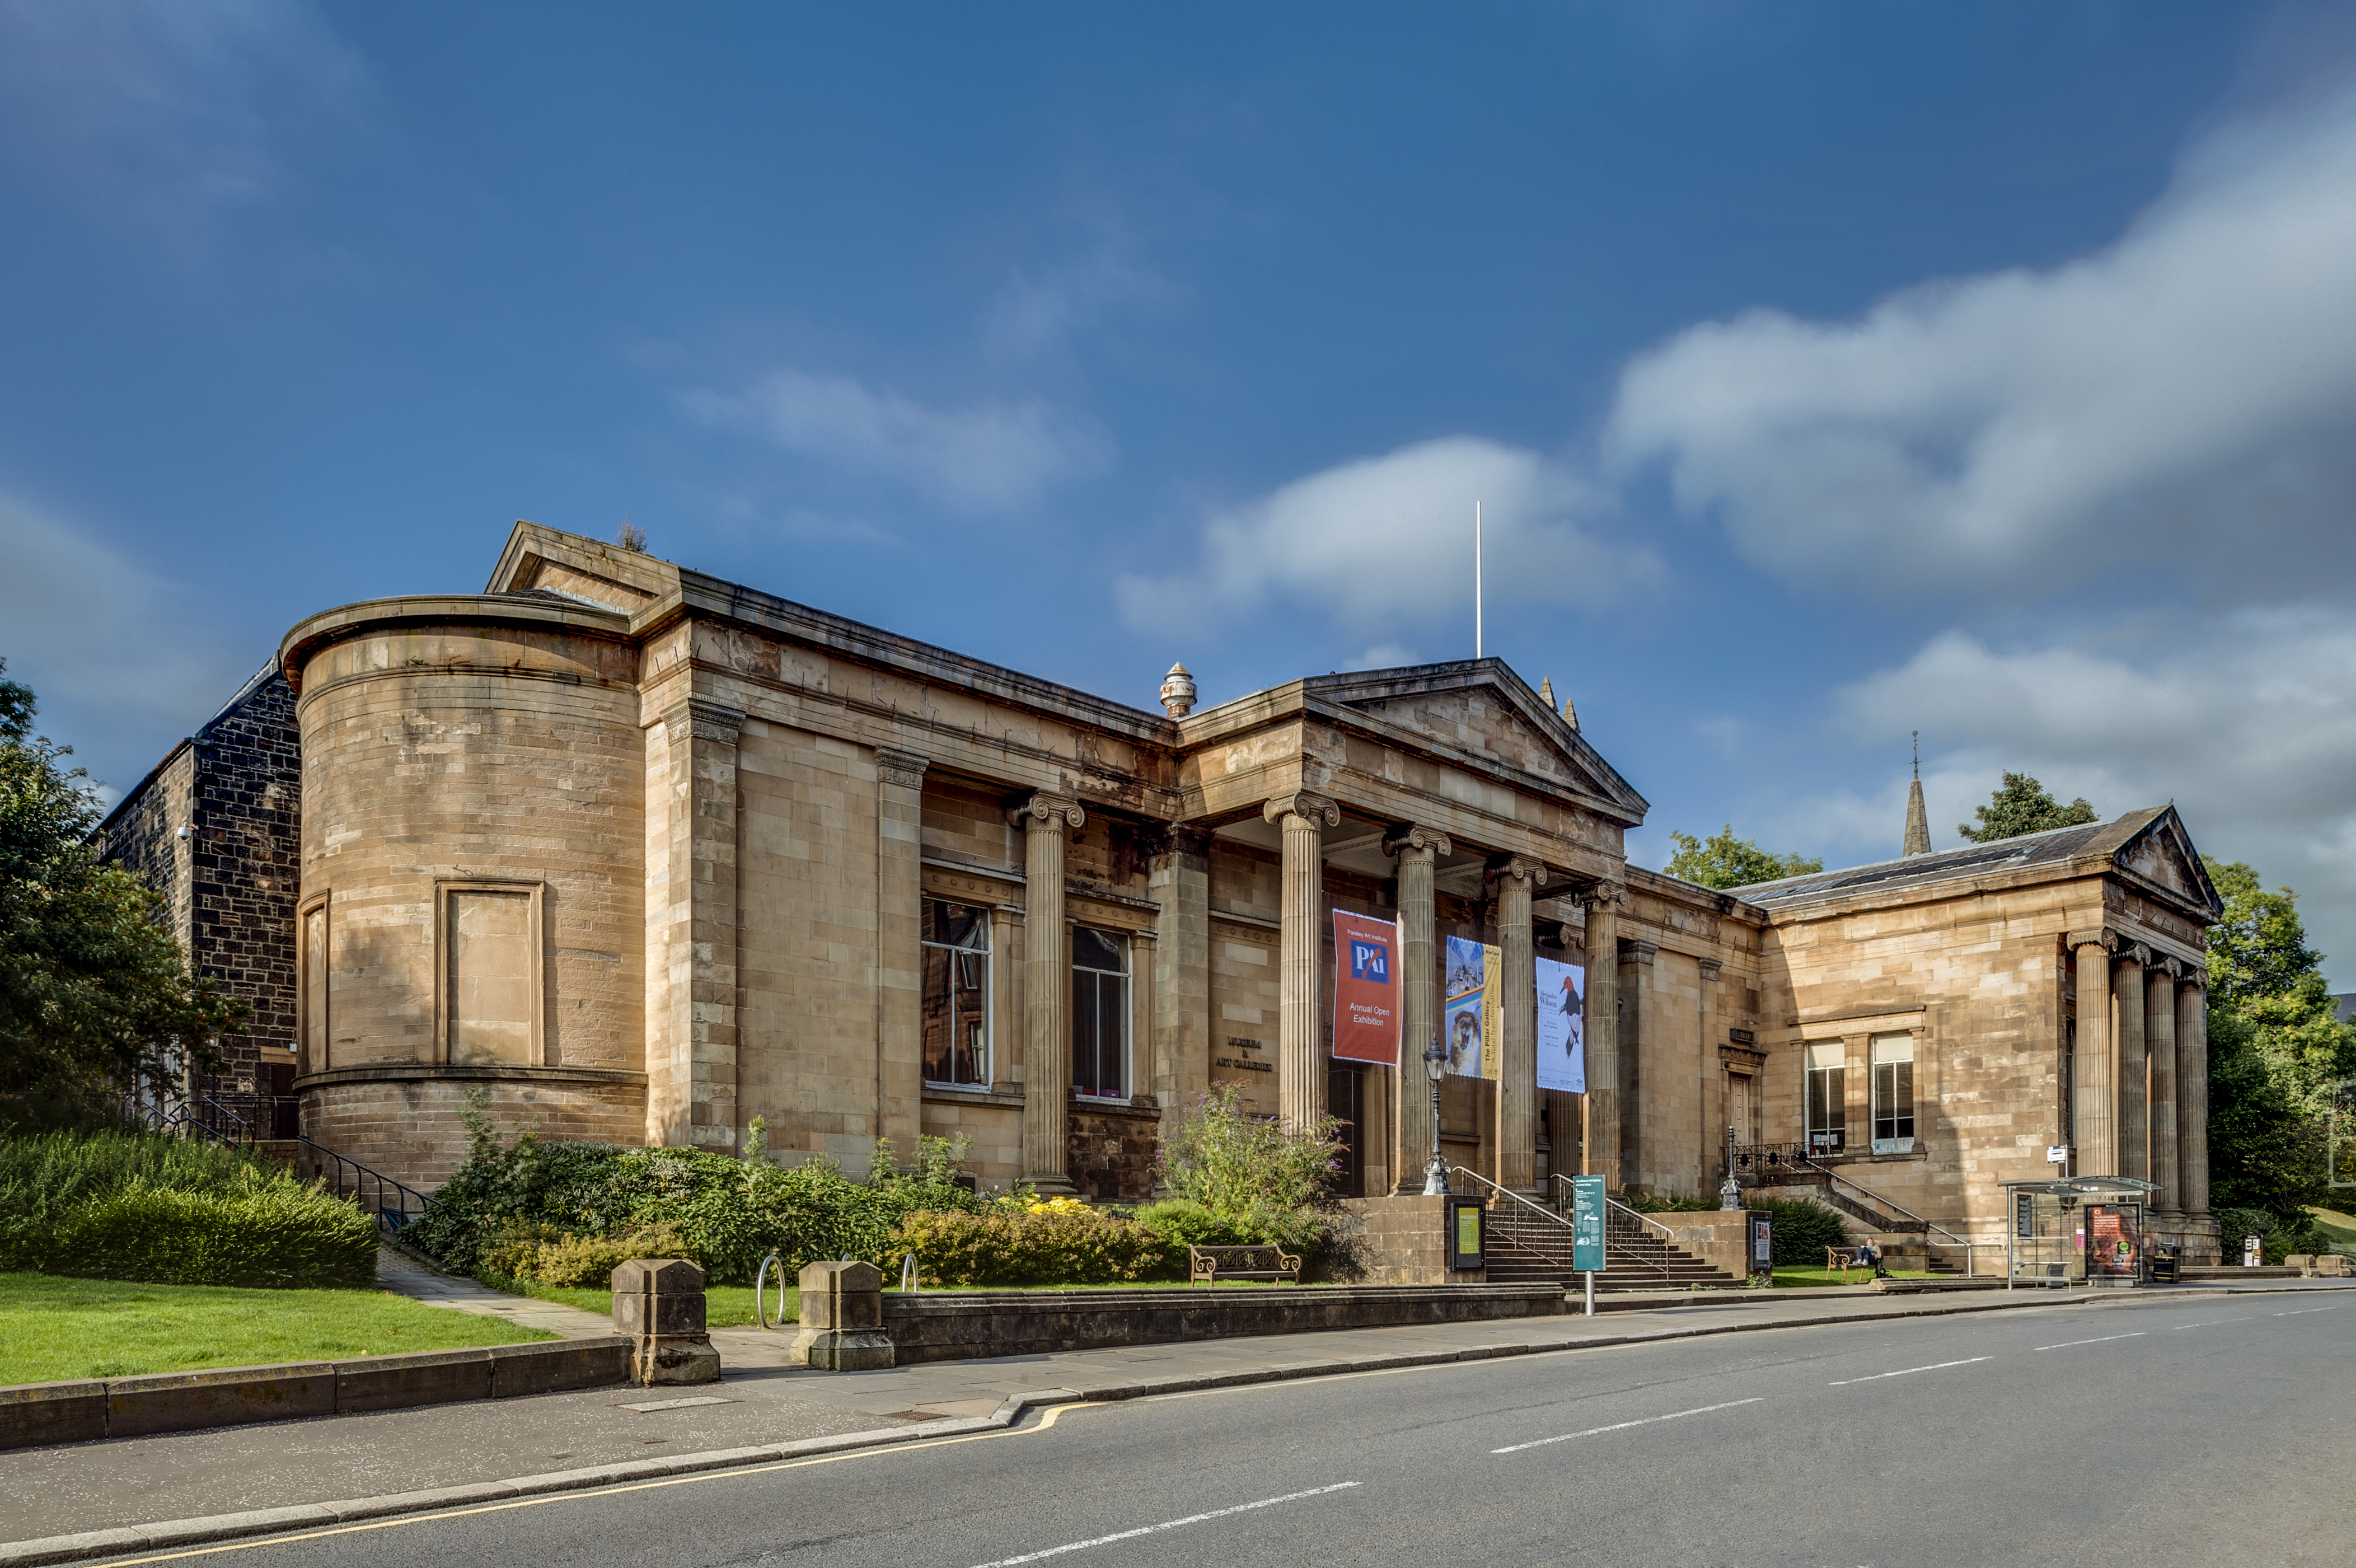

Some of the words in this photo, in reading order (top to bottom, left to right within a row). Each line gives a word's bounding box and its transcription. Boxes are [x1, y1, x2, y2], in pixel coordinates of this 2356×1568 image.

[1347, 929, 1364, 938] Paisley
[1372, 934, 1388, 943] Institute
[1540, 996, 1557, 1008] Wilson
[1349, 1003, 1373, 1013] Annual
[1374, 1006, 1390, 1016] Open
[1353, 1014, 1384, 1026] Exhibition
[1737, 1031, 1752, 1040] LIBRARY
[1228, 1037, 1262, 1049] MUSEUM
[1242, 1050, 1249, 1058] &
[1216, 1057, 1232, 1067] ART
[1233, 1059, 1272, 1072] GALLERIES
